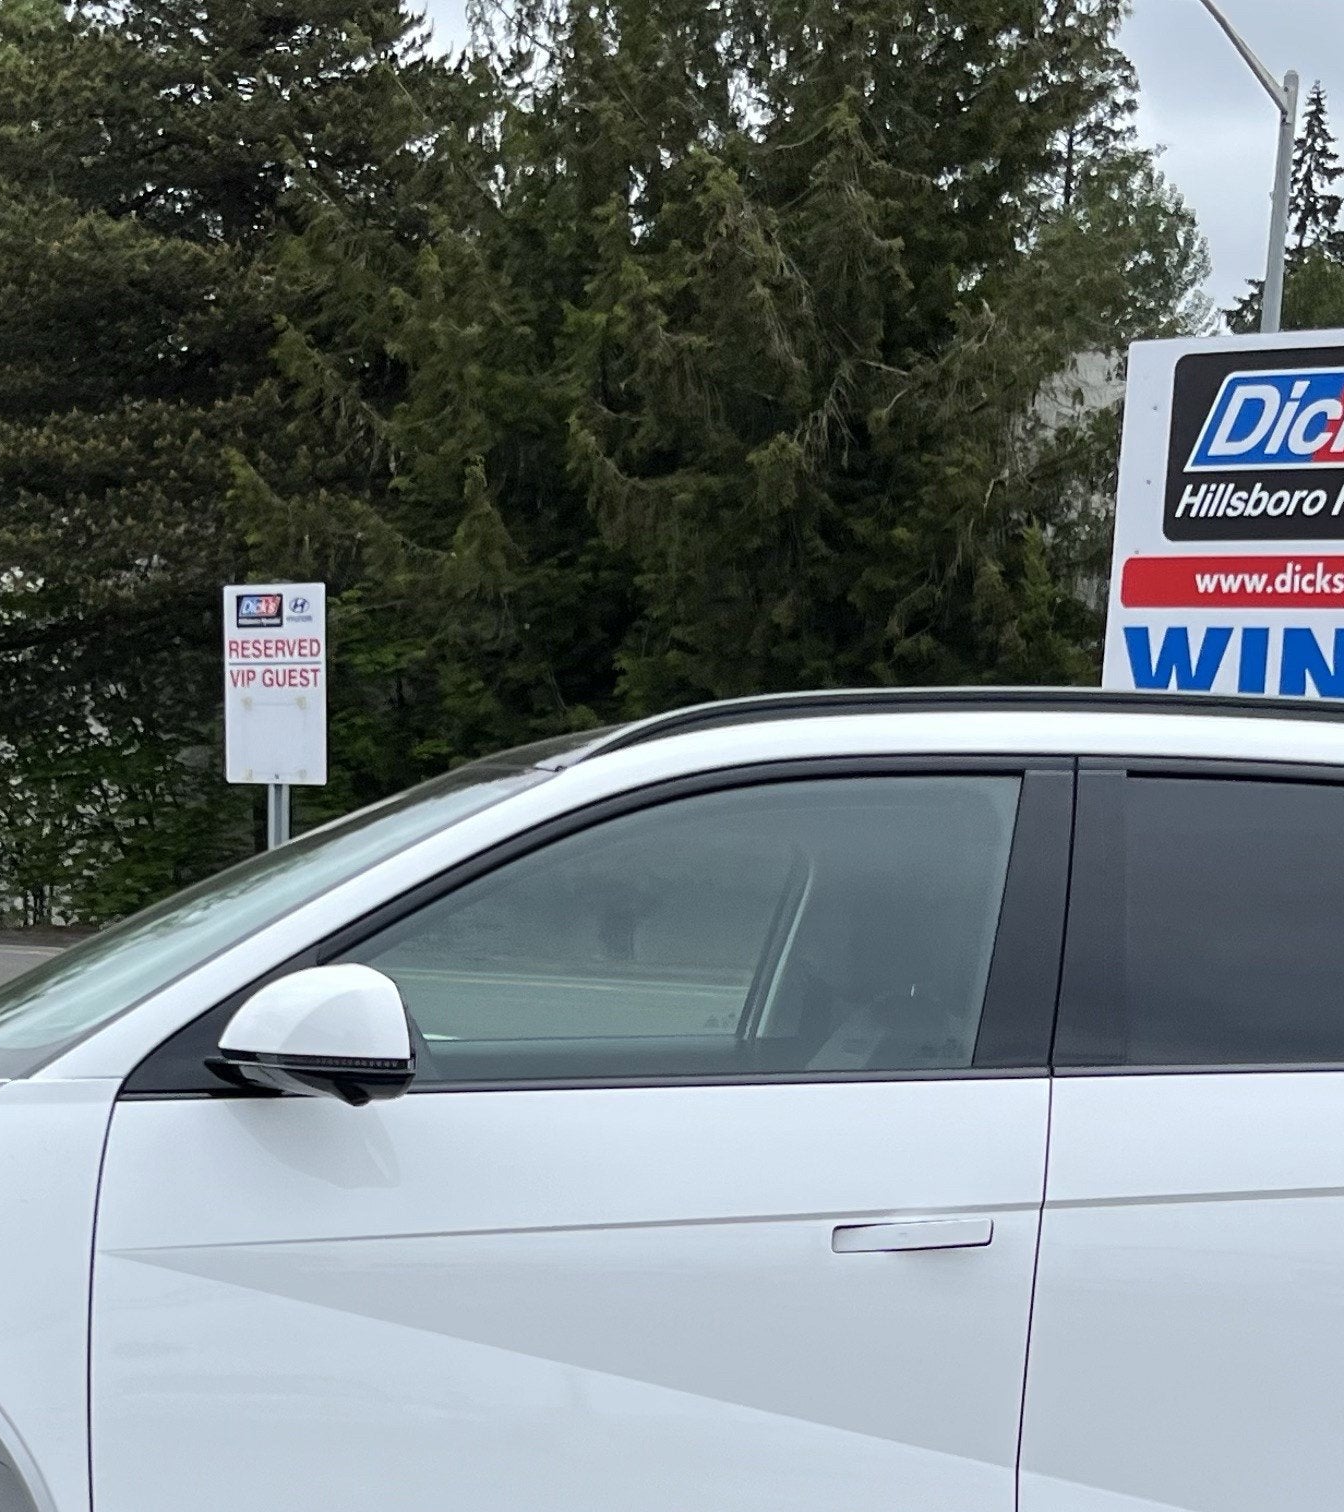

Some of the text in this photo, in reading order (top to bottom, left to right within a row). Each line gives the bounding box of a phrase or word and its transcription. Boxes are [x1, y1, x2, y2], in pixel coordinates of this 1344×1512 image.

[1174, 482, 1327, 518] Hillsboro
[229, 639, 321, 659] RESERVED
[230, 668, 320, 688] VIP GUEST
